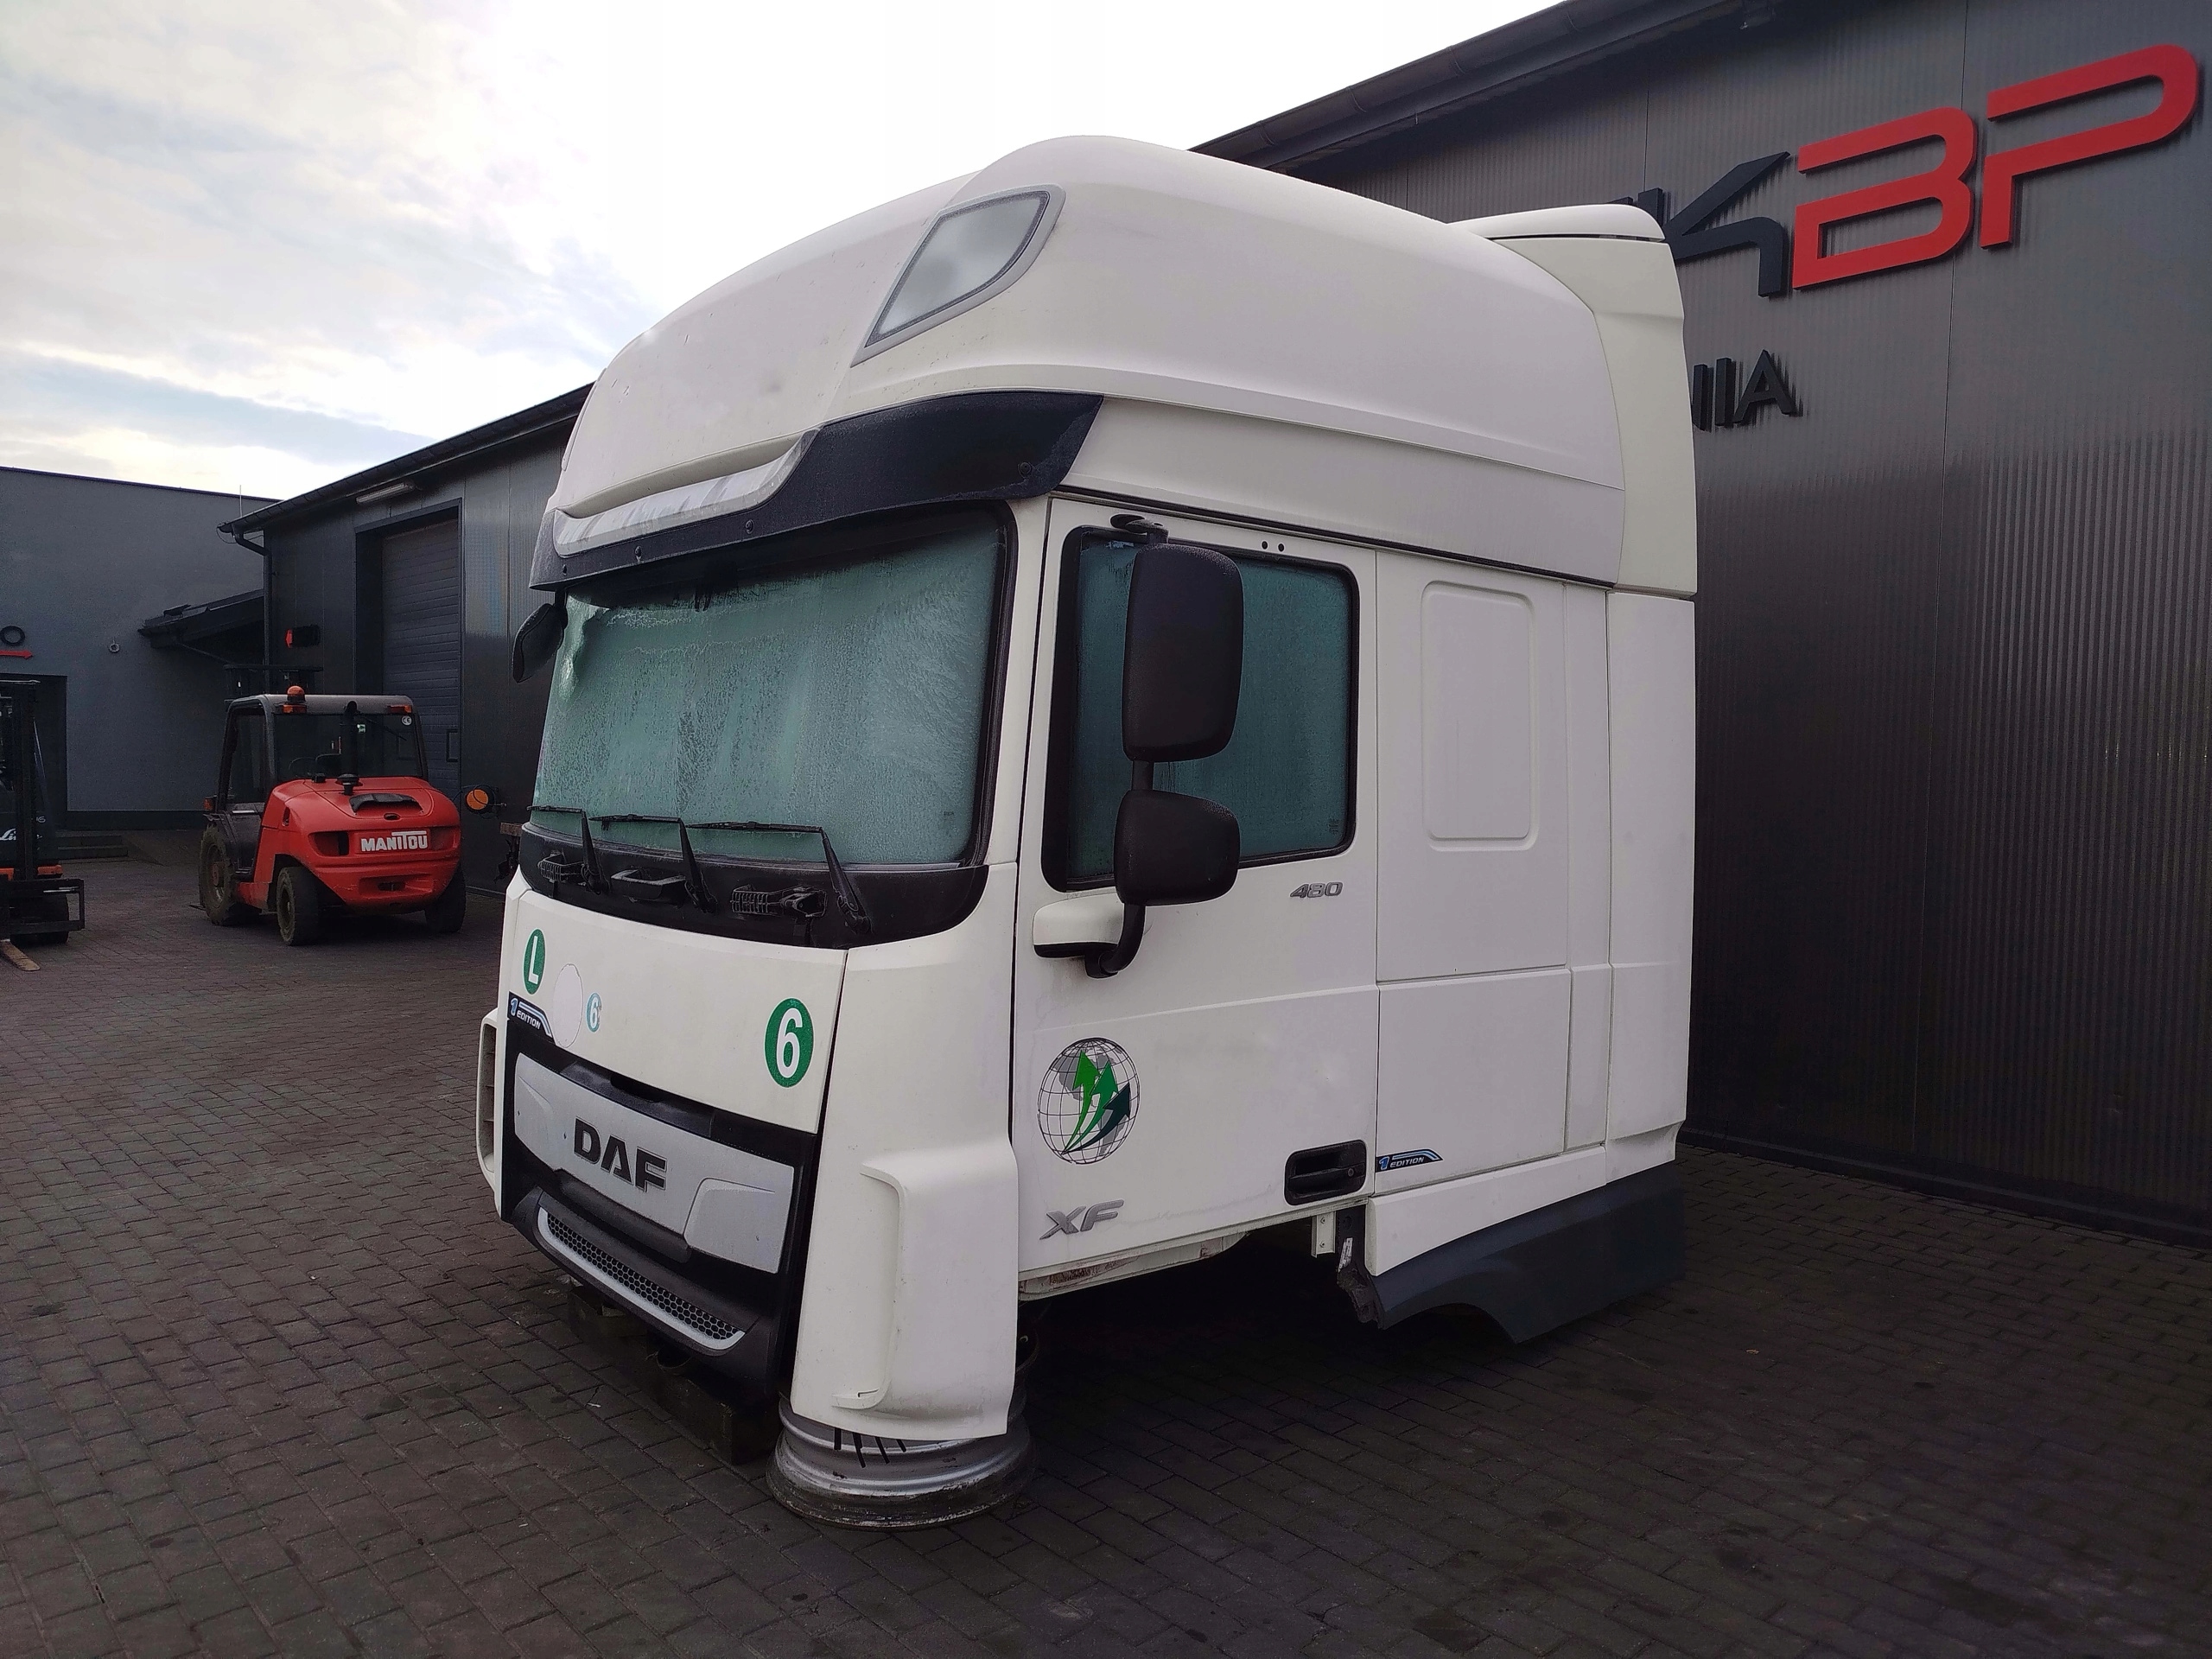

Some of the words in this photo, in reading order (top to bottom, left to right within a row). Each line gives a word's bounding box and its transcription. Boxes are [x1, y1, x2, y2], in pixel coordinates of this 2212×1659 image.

[361, 830, 428, 852] MANITOU
[1289, 881, 1344, 899] 480
[528, 935, 539, 985] L
[517, 1009, 541, 1030] EDITION
[776, 1007, 804, 1078] 6
[574, 1116, 667, 1193] DAF
[1389, 1156, 1425, 1168] EDITION
[1039, 1198, 1124, 1241] XF
